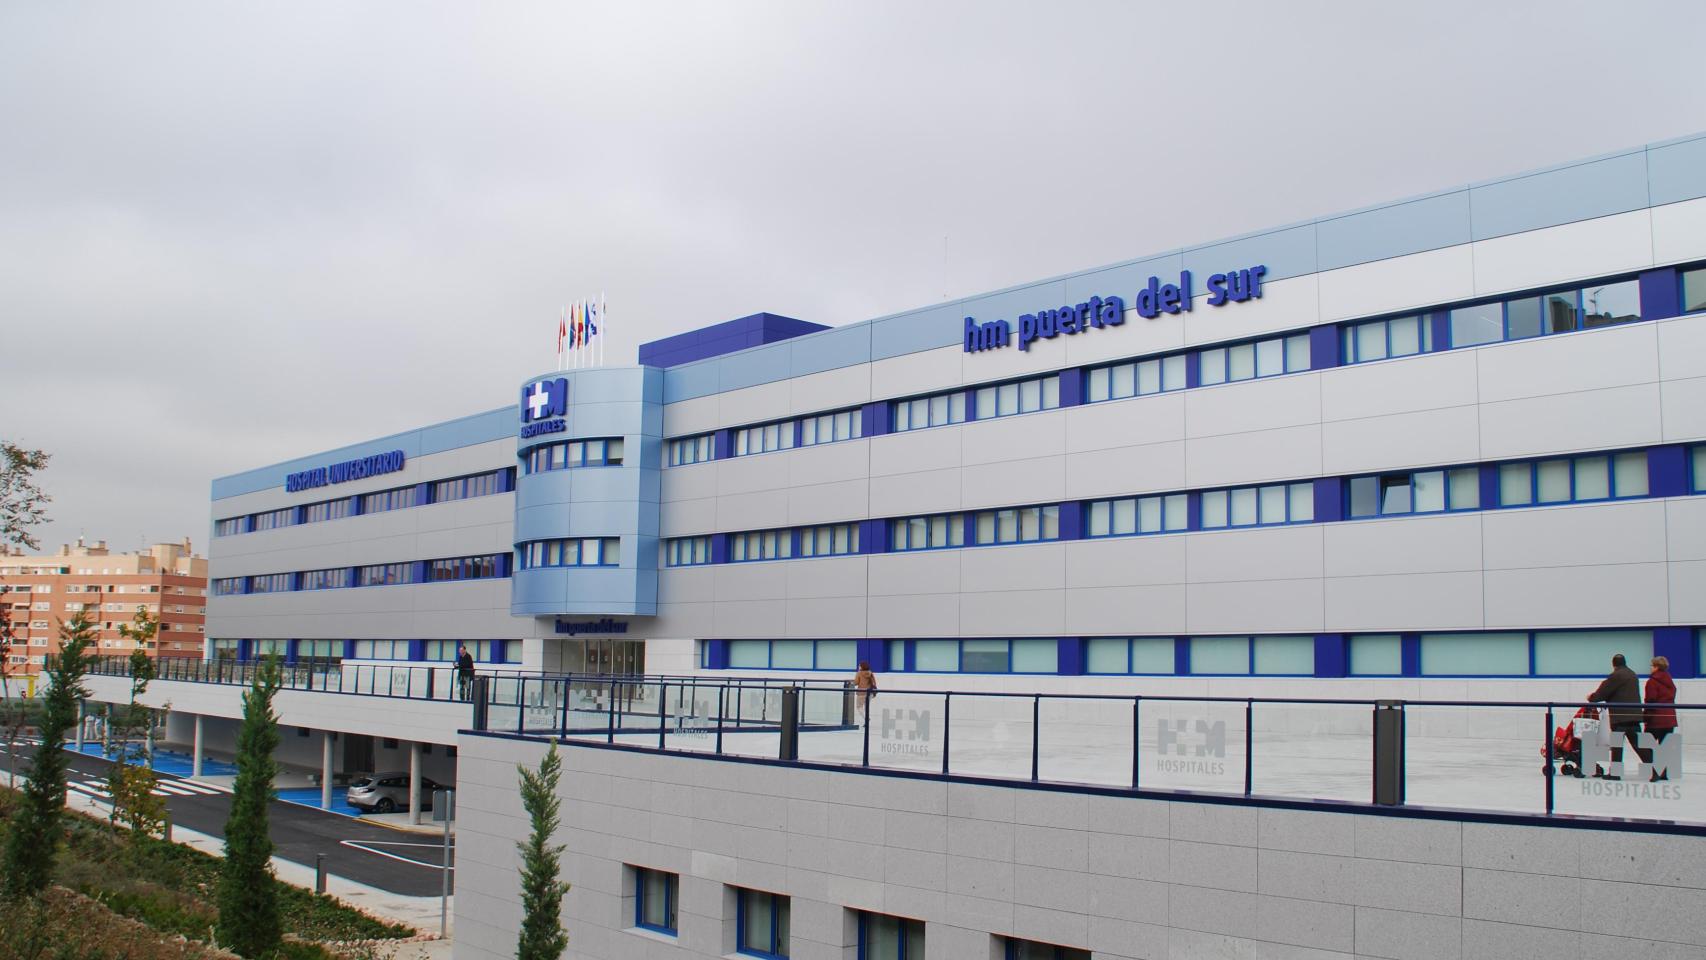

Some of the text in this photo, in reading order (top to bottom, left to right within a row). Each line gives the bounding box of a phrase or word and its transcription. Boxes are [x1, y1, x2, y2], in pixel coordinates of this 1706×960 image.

[964, 264, 1266, 353] hm puerta del sur
[521, 419, 567, 439] HOSPITALES
[286, 449, 405, 493] HOSPITAL UNIVERSITARIO
[882, 708, 931, 742] HM
[1158, 719, 1226, 758] HM
[881, 743, 929, 757] HOSPITALES
[1581, 731, 1683, 780] HM
[1157, 760, 1225, 776] HOSPITALES
[1581, 781, 1682, 801] HOSPITALES
